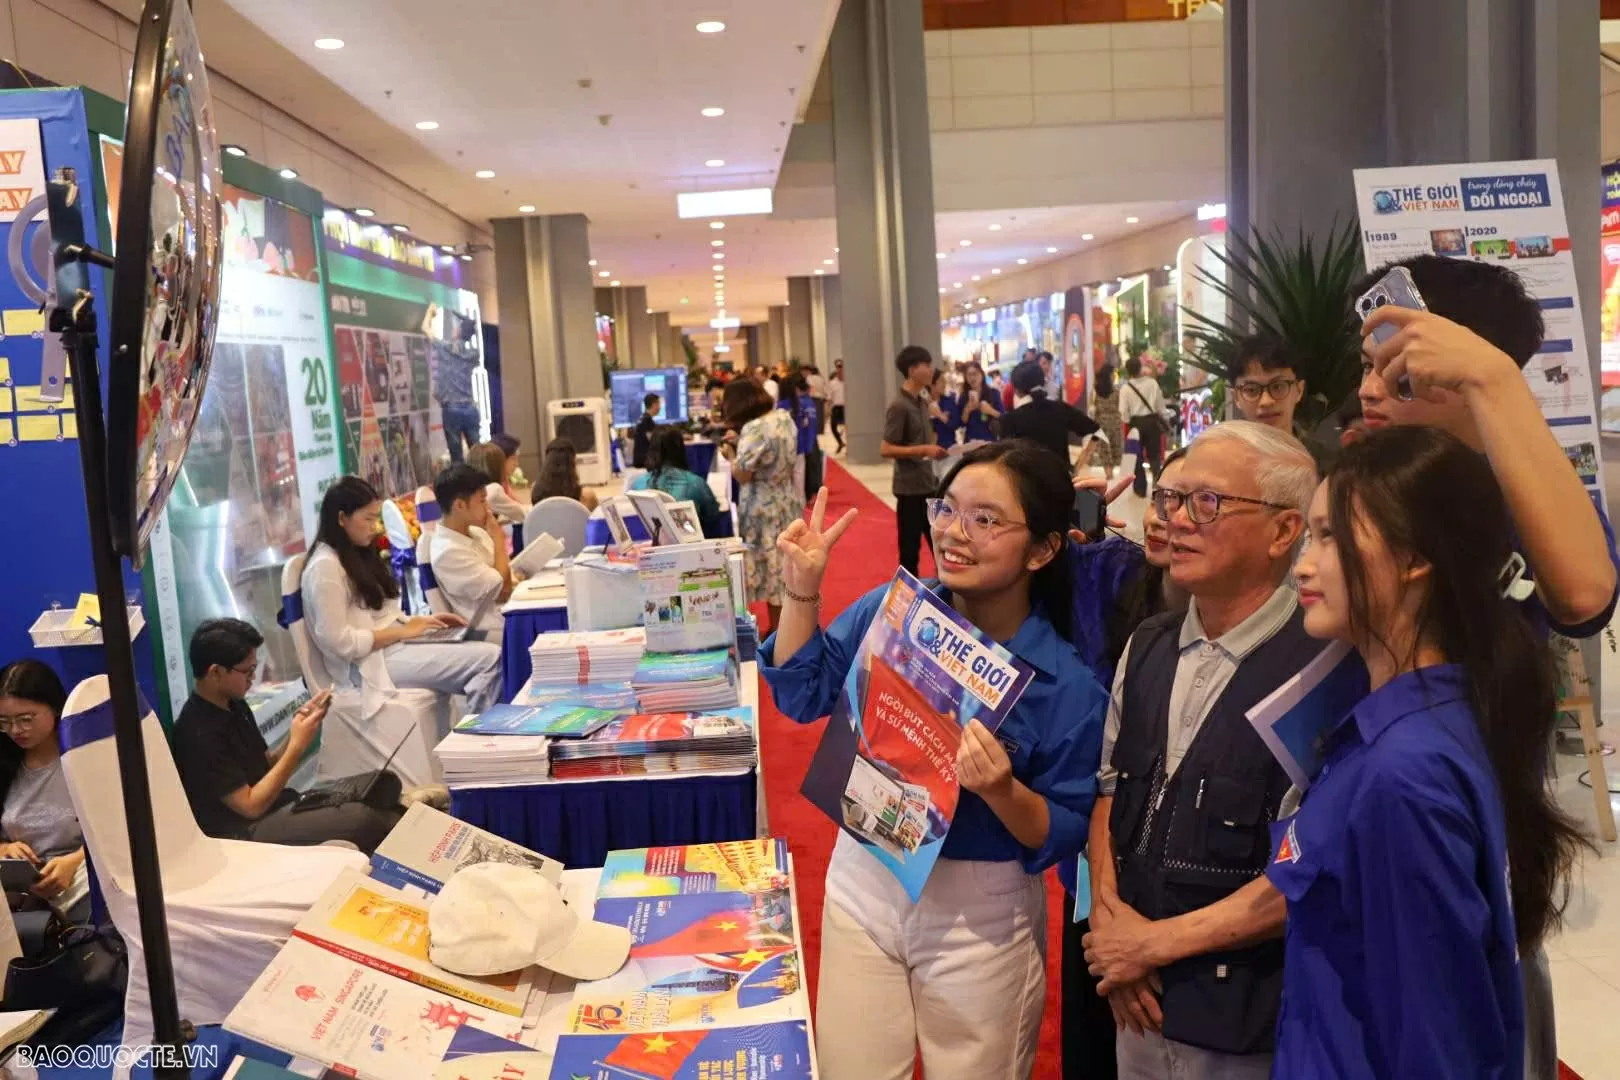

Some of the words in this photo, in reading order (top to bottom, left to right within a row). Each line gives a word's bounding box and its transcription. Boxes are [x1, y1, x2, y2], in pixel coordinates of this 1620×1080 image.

[1432, 200, 1460, 209] NAM
[1470, 192, 1495, 208] ĐỐI
[1500, 191, 1543, 207] NGOẠI
[1370, 232, 1397, 241] 1989
[1470, 227, 1498, 236] 2020
[301, 357, 327, 406] 20
[939, 628, 976, 663] THẾ
[971, 655, 1011, 693] GIỚI
[966, 673, 1001, 704] NAM
[903, 708, 923, 728] BÚT
[922, 726, 946, 752] CÁCH
[333, 964, 364, 1006] SINGAPORE
